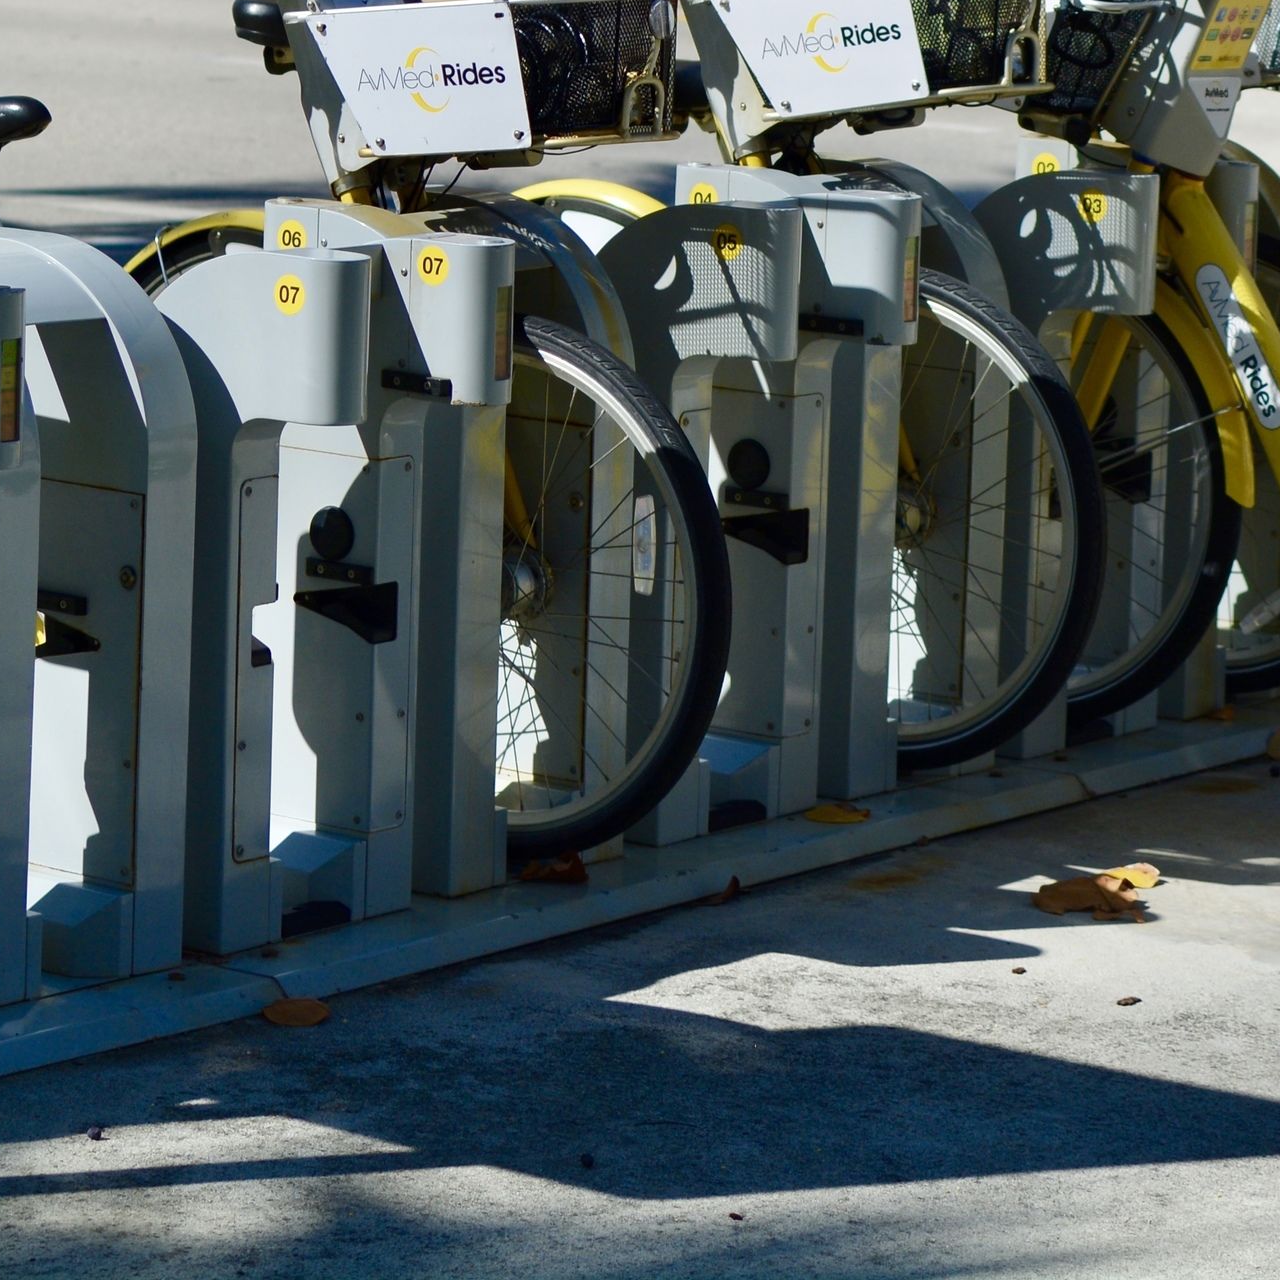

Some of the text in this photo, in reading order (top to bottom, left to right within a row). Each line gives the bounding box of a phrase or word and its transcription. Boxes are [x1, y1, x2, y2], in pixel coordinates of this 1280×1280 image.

[762, 22, 902, 60] AvMed Rides
[358, 62, 506, 92] AvMed Rides
[1081, 196, 1102, 215] 03
[282, 229, 302, 248] 06
[717, 232, 737, 252] 05
[422, 256, 444, 276] 07
[279, 285, 300, 304] 07
[1239, 354, 1276, 418] Rides
